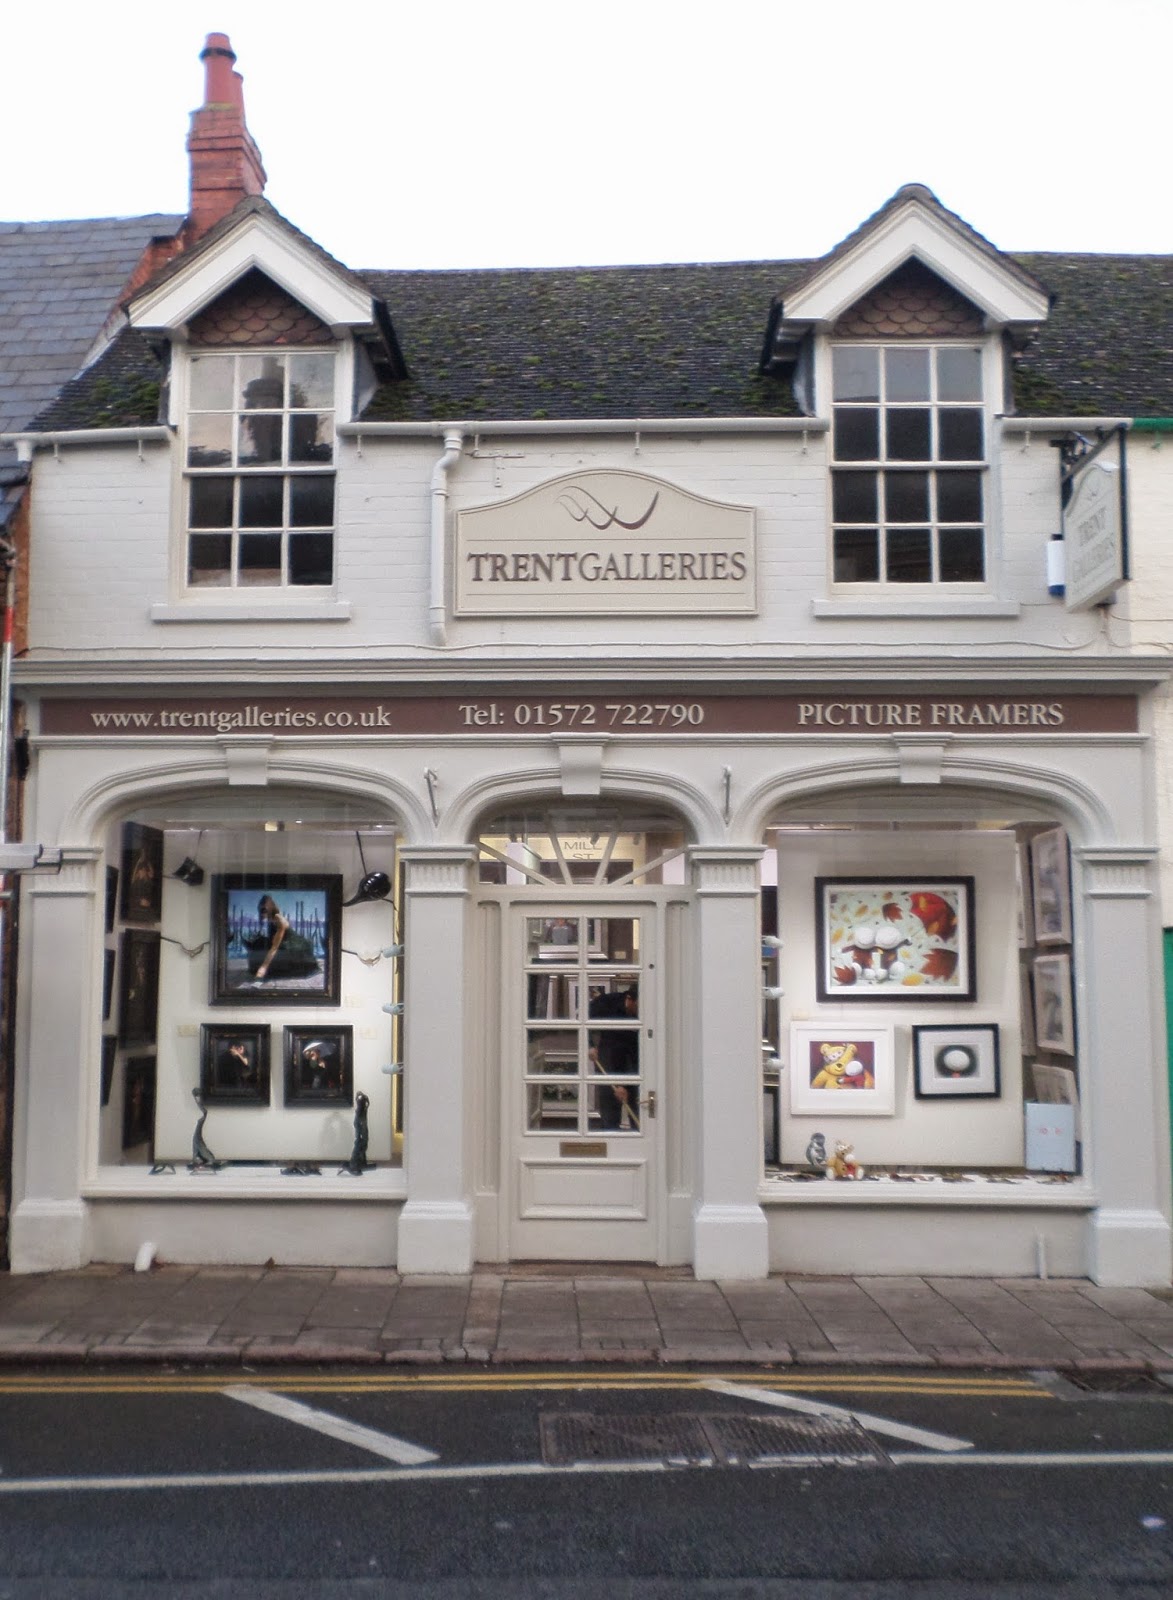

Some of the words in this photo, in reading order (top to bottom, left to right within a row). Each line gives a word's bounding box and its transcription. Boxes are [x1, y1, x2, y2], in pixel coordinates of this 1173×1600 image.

[467, 551, 747, 582] TRENTGALLERIES
[90, 706, 392, 732] www.trentgalleries.co.uk
[459, 704, 505, 725] Tel:
[514, 704, 596, 726] 01572
[605, 704, 705, 726] 722790
[797, 704, 922, 726] PICTURE
[930, 703, 1065, 726] FRAMERS
